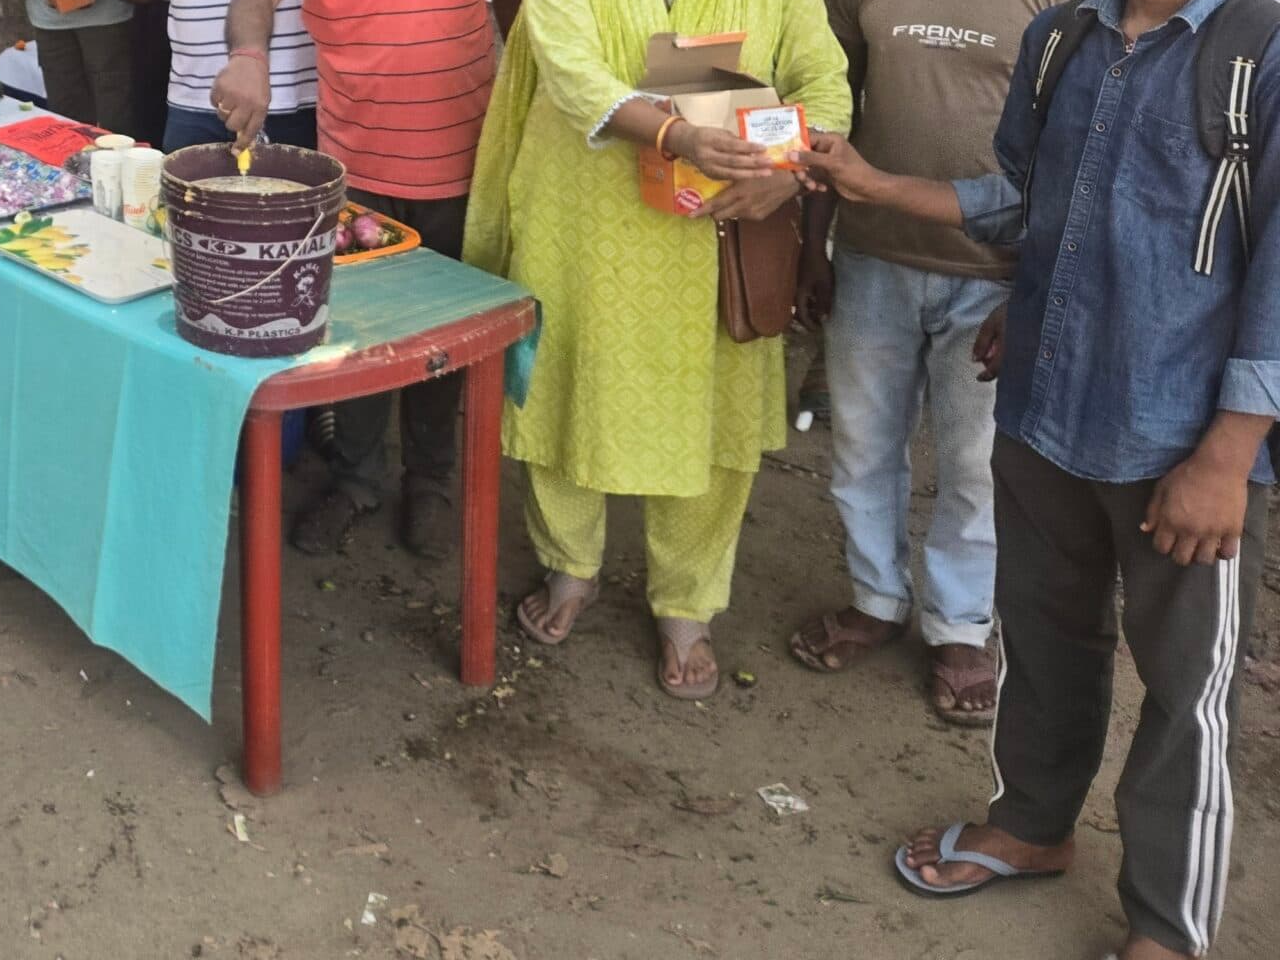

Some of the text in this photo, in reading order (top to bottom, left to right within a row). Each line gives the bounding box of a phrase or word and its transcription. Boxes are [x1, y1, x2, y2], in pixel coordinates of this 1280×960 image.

[892, 24, 997, 48] FRANCE
[258, 239, 326, 260] KAMAL
[292, 262, 321, 280] KAMAL
[247, 326, 302, 339] PLASTICS
